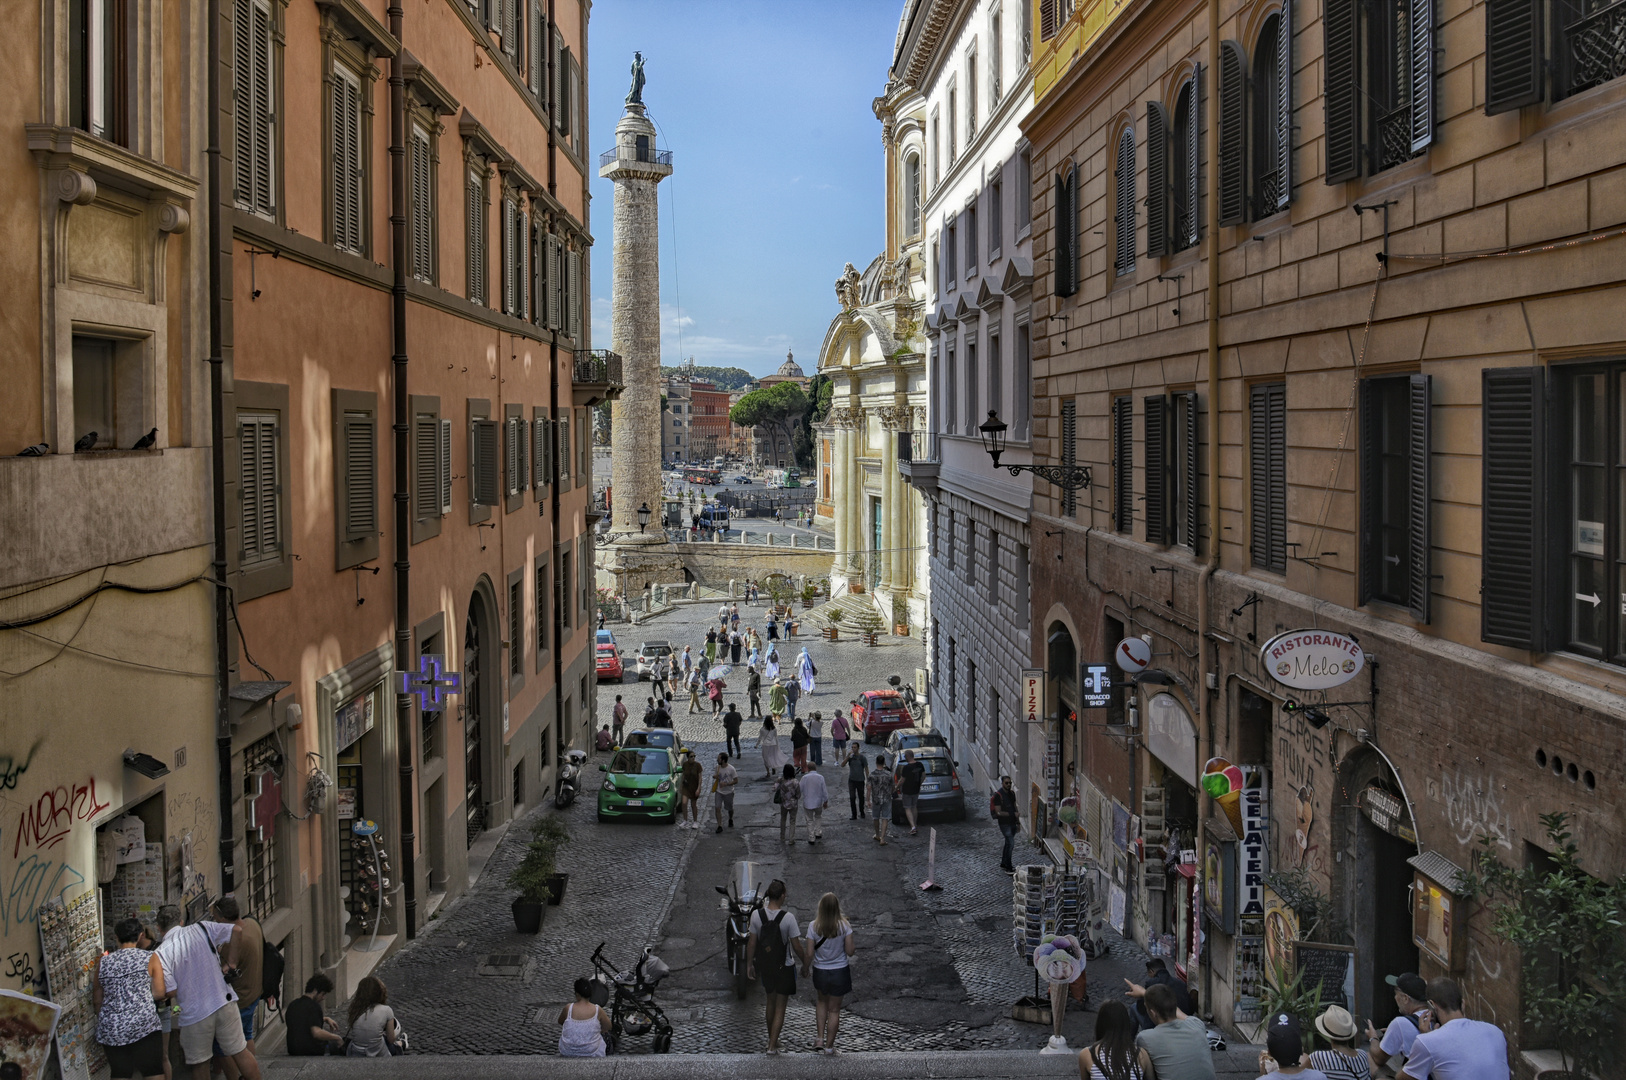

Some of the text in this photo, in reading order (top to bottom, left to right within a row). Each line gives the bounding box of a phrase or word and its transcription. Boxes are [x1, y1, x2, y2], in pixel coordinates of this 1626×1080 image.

[1271, 634, 1360, 660] RISTORANTE
[1087, 666, 1107, 693] T
[1293, 654, 1340, 680] Melo
[1028, 679, 1036, 721] PIZZA
[176, 750, 185, 767] 10
[1429, 780, 1437, 798] 6
[1243, 791, 1264, 914] GELATERIA
